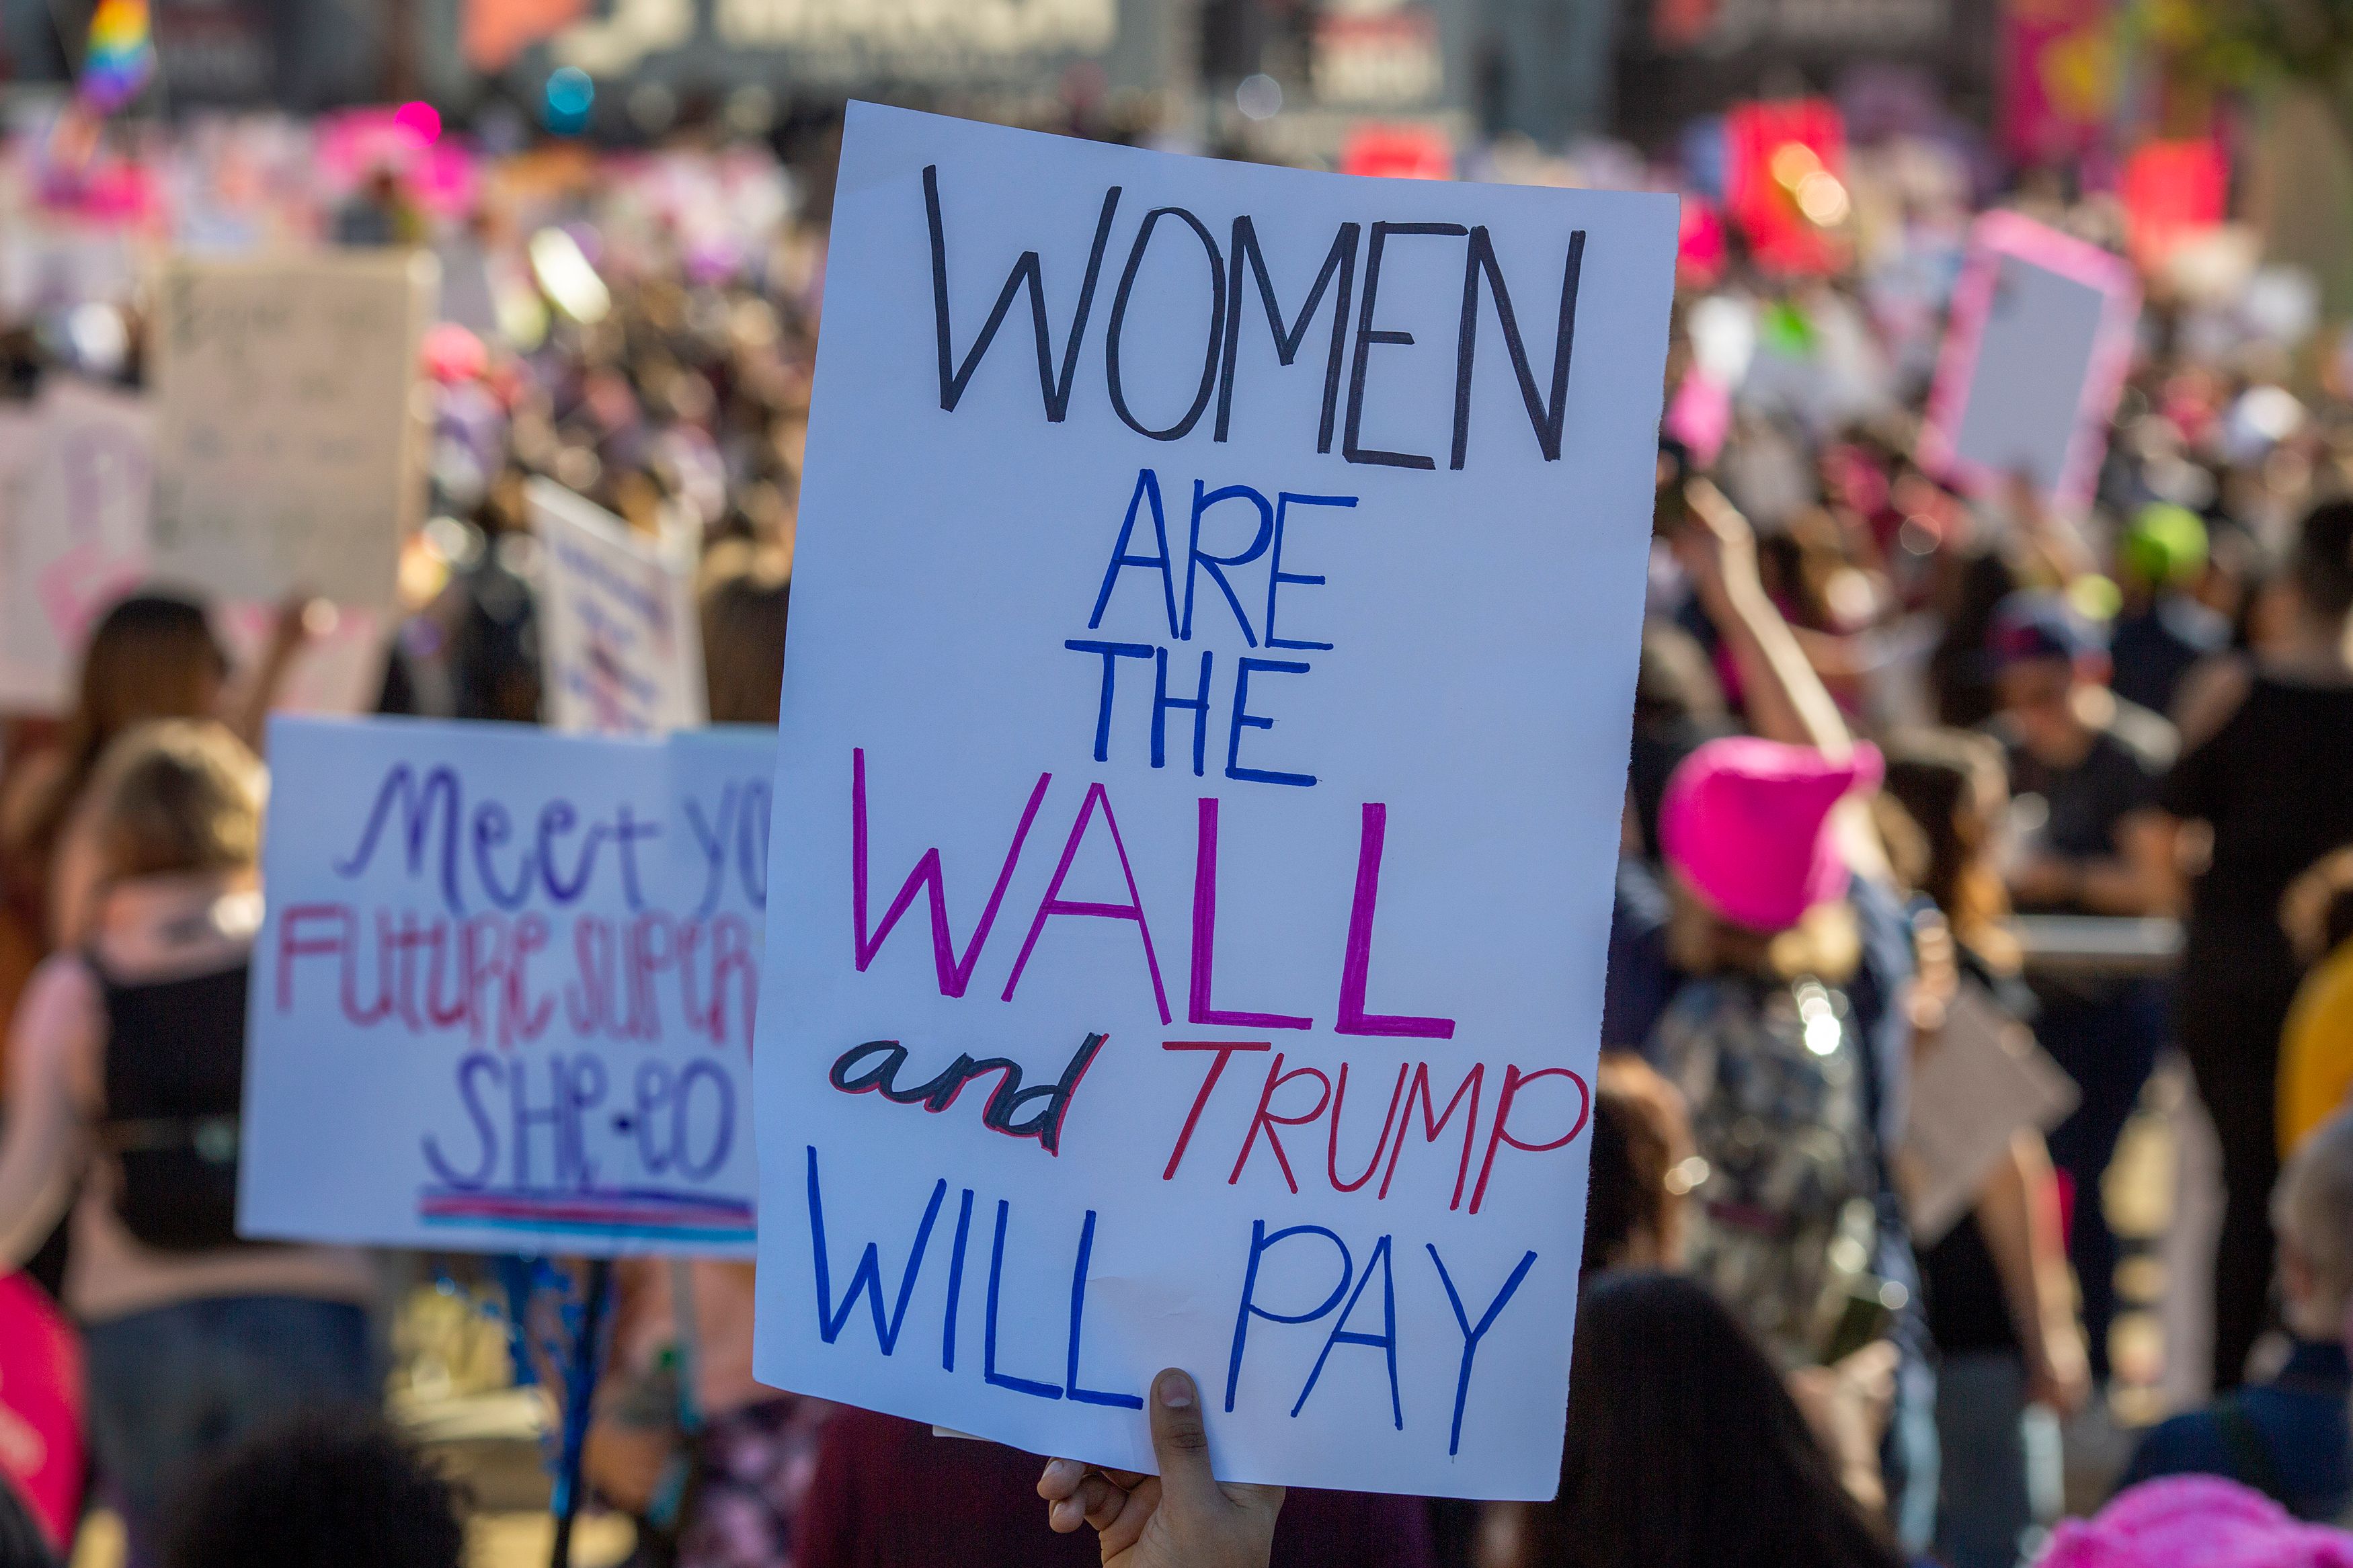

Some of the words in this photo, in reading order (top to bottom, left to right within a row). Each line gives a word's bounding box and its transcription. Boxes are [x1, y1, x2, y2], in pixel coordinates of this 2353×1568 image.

[921, 163, 1587, 472] WOMEN
[1086, 468, 1360, 652] ARE
[1064, 638, 1335, 788] THE
[333, 760, 661, 919] Meet
[851, 746, 1457, 1040] WALL
[828, 1031, 1111, 1159] and
[1161, 1039, 1591, 1216] TRUMP
[805, 1144, 1144, 1411] WILL
[1224, 1218, 1539, 1457] PAY
